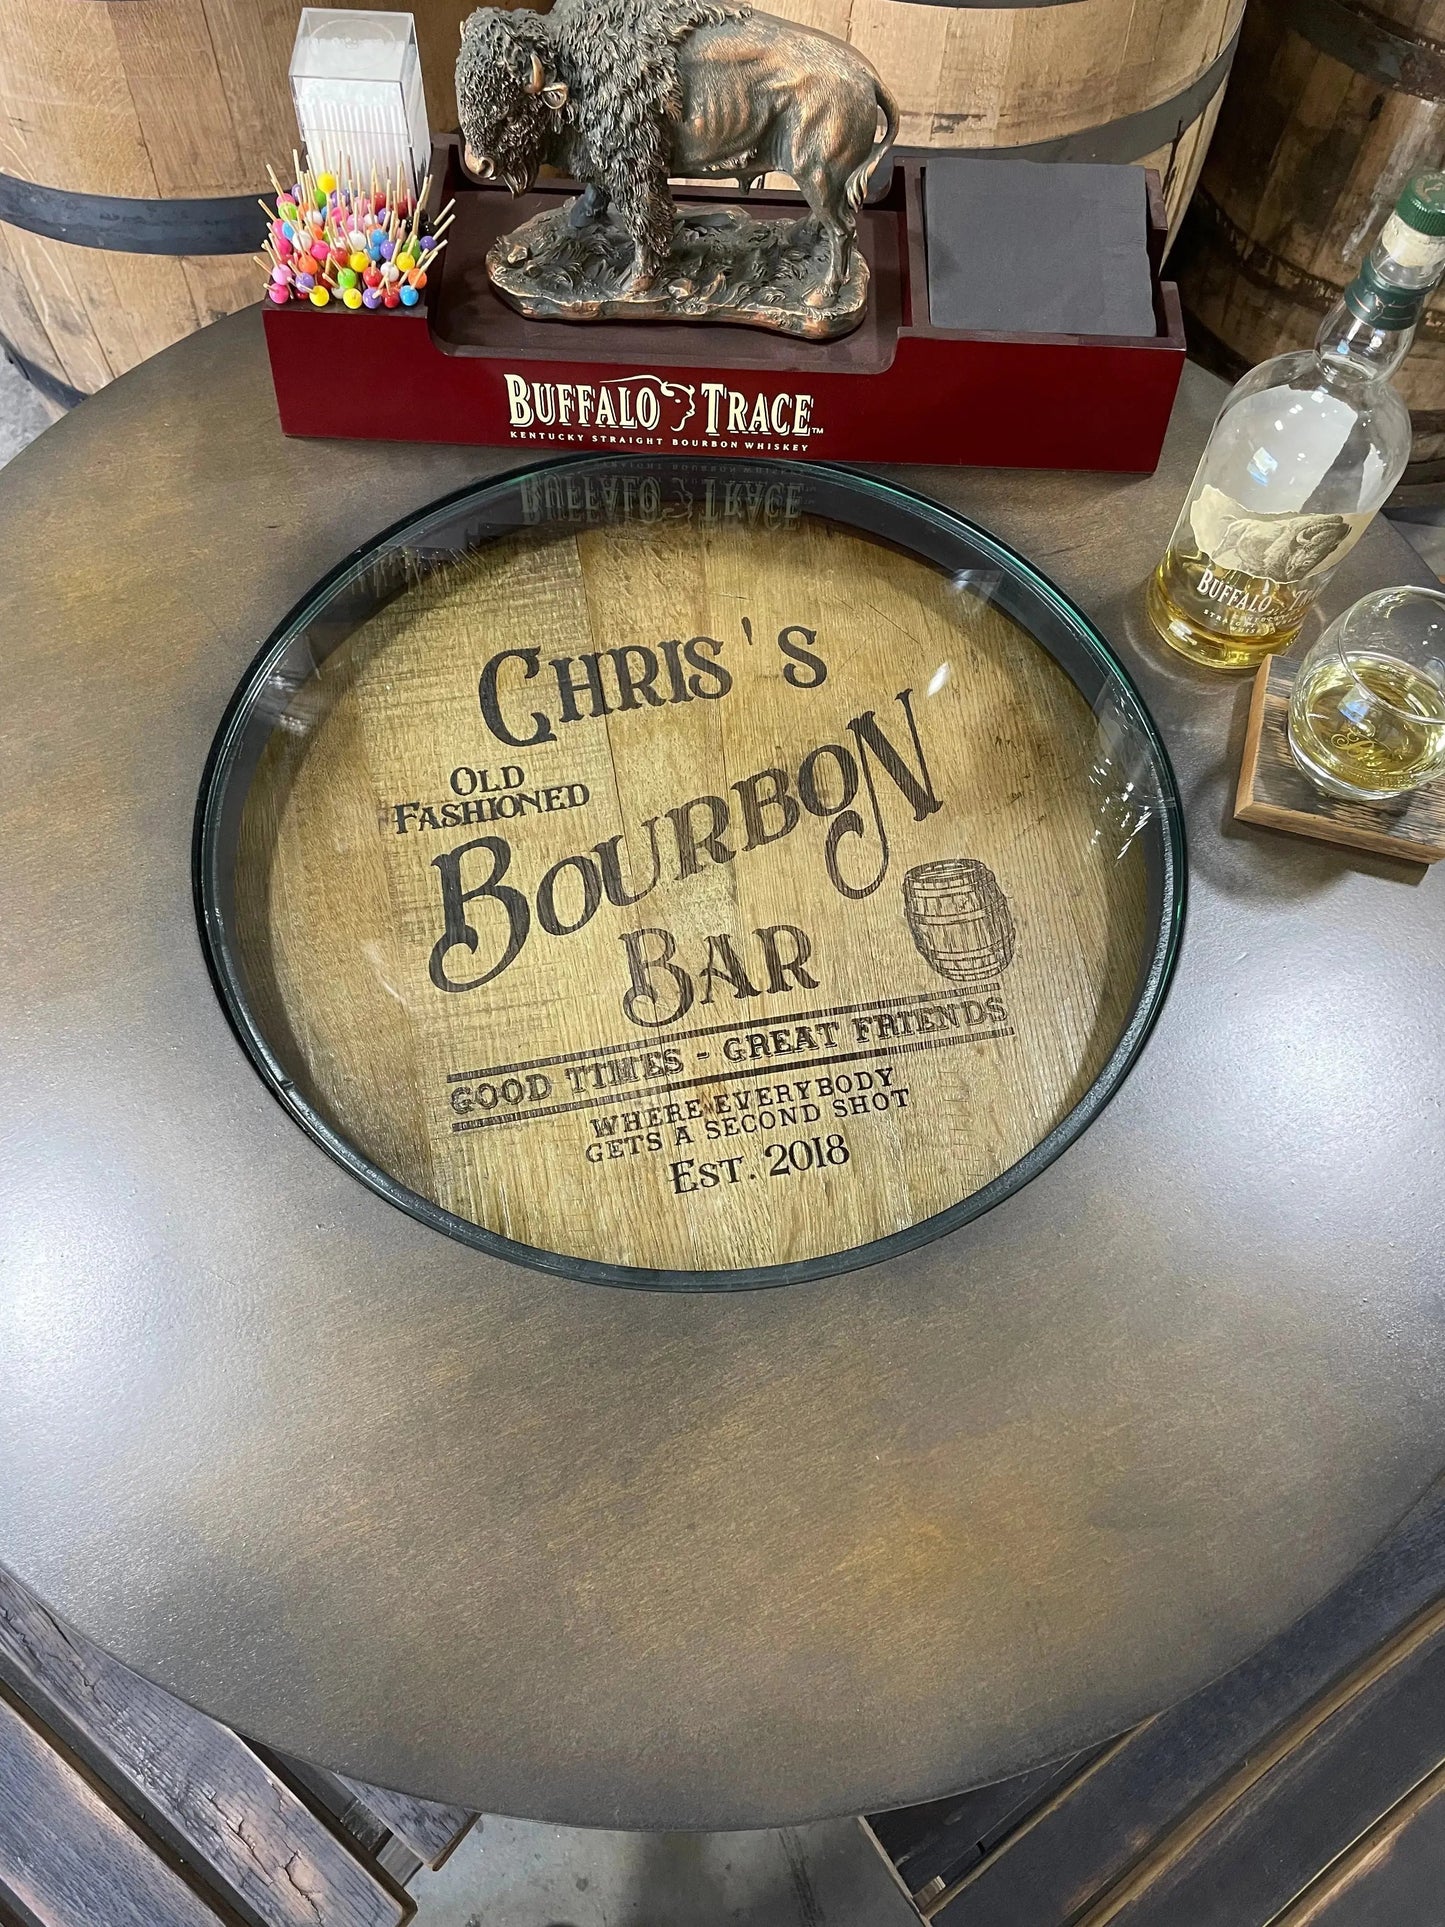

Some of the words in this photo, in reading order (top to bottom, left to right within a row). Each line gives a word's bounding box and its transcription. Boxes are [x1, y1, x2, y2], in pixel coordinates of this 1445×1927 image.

[504, 374, 661, 431] BUFFALO
[510, 431, 584, 442] KENTUCKY
[592, 435, 663, 445] STRAIGHT
[672, 438, 738, 449] BOURBON
[745, 441, 809, 452] WHISKEY
[1196, 567, 1273, 613] BUFFALO
[393, 783, 590, 835] FASHIONED
[450, 765, 525, 796] OLD
[428, 687, 944, 993] BOURBON
[619, 924, 821, 1028] BAR
[450, 1073, 553, 1116] GOOD
[565, 1048, 685, 1094] TIMES
[723, 1020, 840, 1064] GREAT
[851, 996, 1009, 1044] FRIENDS
[585, 1131, 663, 1164] GETS
[675, 1125, 695, 1146] A
[705, 1103, 822, 1141] SECOND
[833, 1087, 909, 1118] SHOT
[589, 1099, 703, 1139] WHERE
[714, 1066, 895, 1116] EVERYBODY
[669, 1156, 757, 1195] EST.
[764, 1133, 851, 1178] 2018
